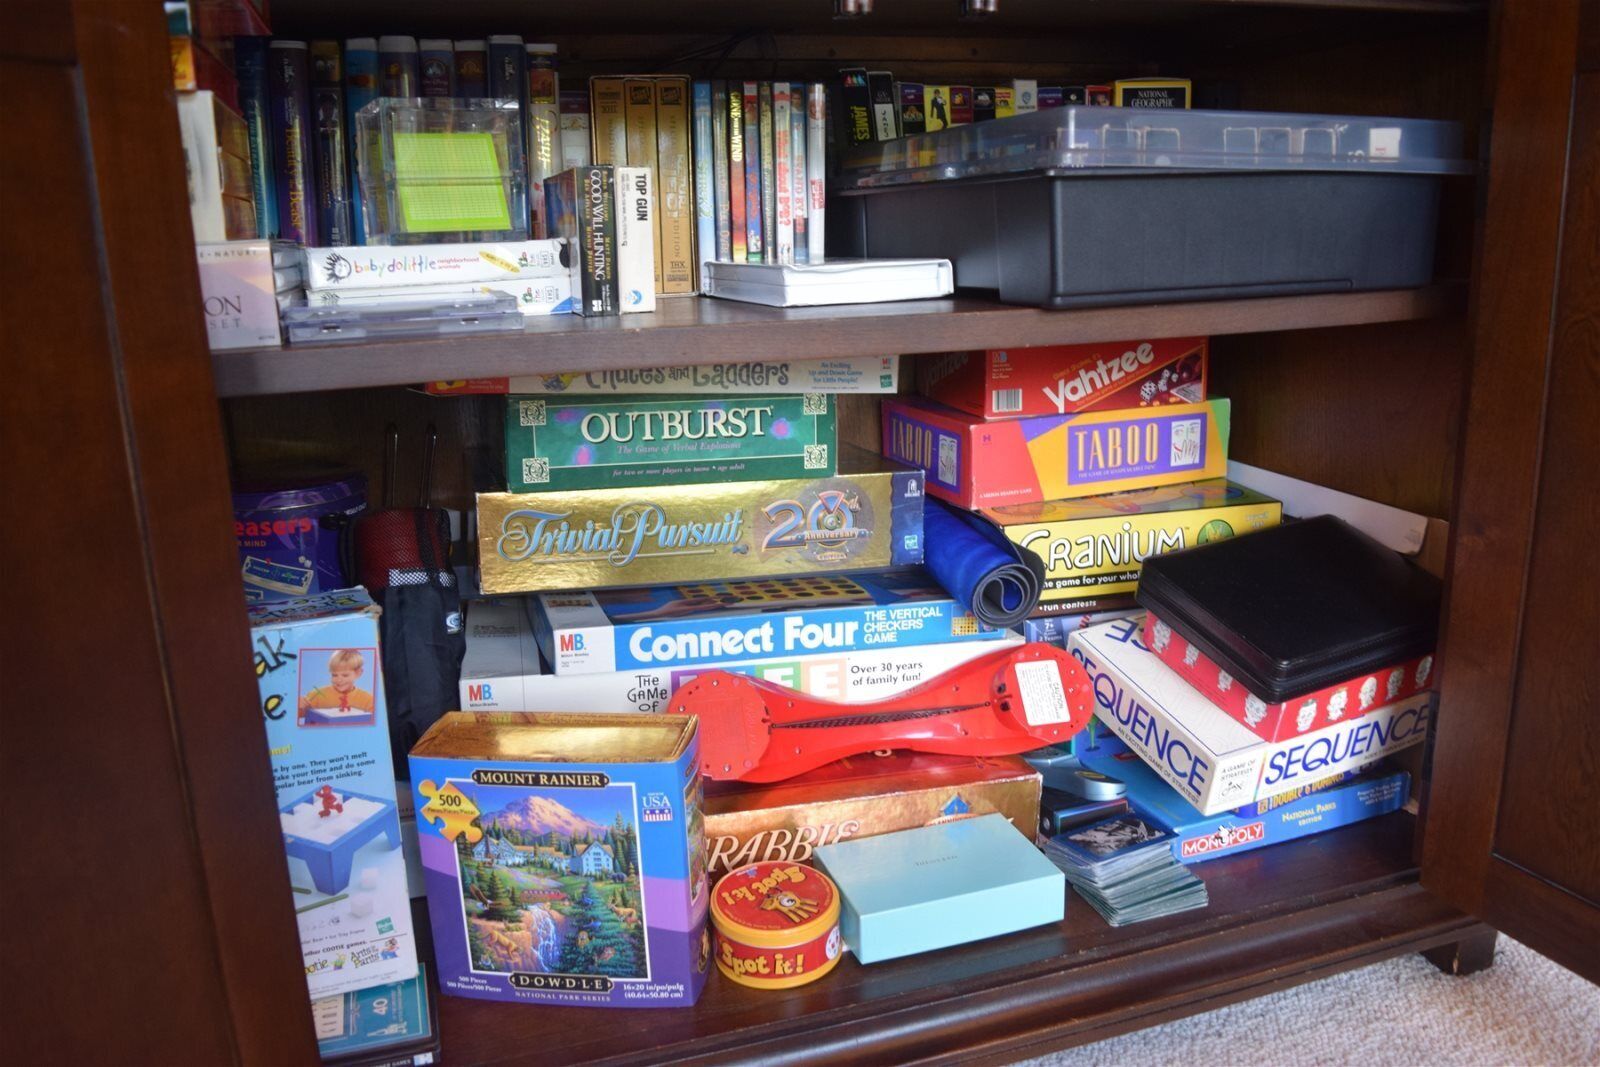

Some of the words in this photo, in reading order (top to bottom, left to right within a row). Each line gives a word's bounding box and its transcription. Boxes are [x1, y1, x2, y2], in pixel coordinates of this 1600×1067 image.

[730, 91, 741, 118] GONE
[851, 105, 870, 141] JAMES
[732, 135, 743, 162] WIND
[591, 170, 602, 203] GOOD
[635, 174, 647, 195] TOP
[289, 191, 305, 227] Beast
[592, 204, 604, 230] WILL
[636, 198, 648, 221] GUN
[437, 257, 480, 265] neighborhood
[594, 232, 606, 281] HUNTING
[354, 257, 386, 278] baby
[210, 318, 241, 330] SET
[668, 367, 689, 380] and
[1042, 342, 1155, 414] Yahtzee
[580, 406, 772, 443] OUTBURST
[617, 445, 633, 454] The
[636, 444, 659, 454] Game
[662, 444, 670, 454] of
[673, 443, 698, 451] Verbal
[892, 418, 932, 470] TABOO
[1075, 422, 1159, 471] TABOO
[612, 469, 622, 477] for
[662, 466, 682, 476] players
[233, 516, 312, 537] easers
[497, 508, 624, 562] Trivial
[608, 500, 744, 568] Pursuit
[804, 527, 859, 540] Anniversary
[1042, 578, 1053, 589] he
[1055, 579, 1081, 589] game
[1082, 575, 1095, 584] for
[1097, 576, 1118, 587] your
[1119, 571, 1141, 581] whol
[864, 610, 886, 621] THE
[889, 606, 943, 620] VERTICAL
[1062, 600, 1097, 610] contests
[864, 619, 923, 633] CHECKERS
[629, 620, 774, 663] Connect
[784, 615, 859, 651] Four
[864, 632, 897, 644] GAME
[253, 635, 297, 678] ak
[850, 664, 878, 674] Over
[880, 662, 892, 672] 30
[896, 661, 923, 673] years
[852, 677, 864, 686] of
[866, 674, 898, 688] family
[902, 672, 922, 682] fun!
[1264, 704, 1430, 785] SEQUENCE
[280, 764, 289, 773] by
[310, 759, 327, 768] They
[329, 754, 349, 763] won't
[351, 751, 367, 760] melt
[292, 771, 309, 780] your
[310, 767, 327, 775] time
[329, 763, 343, 772] and
[356, 759, 376, 767] some
[1118, 726, 1126, 737] AN
[1124, 731, 1149, 758] EXCITING
[1149, 753, 1164, 774] GAME
[1163, 769, 1172, 779] OF
[1171, 776, 1200, 805] STRATEGY
[1227, 762, 1246, 773] GAME
[1247, 759, 1256, 767] OF
[297, 778, 314, 786] bear
[316, 775, 333, 783] from
[335, 770, 365, 780] sinking.
[479, 771, 536, 786] MOUNT
[538, 773, 602, 787] RAINIER
[1221, 767, 1253, 780] STRATEGY
[439, 794, 461, 807] 500
[642, 796, 671, 808] USA
[1272, 788, 1303, 808] DOUBLE
[1299, 815, 1322, 826] EDITION
[705, 819, 860, 872] RABBLE
[1183, 826, 1264, 857] MONOPOLY
[751, 866, 807, 895] Spot
[721, 885, 757, 906] it!
[303, 949, 321, 957] other
[322, 944, 345, 954] COOTIE
[346, 940, 368, 949] games.
[721, 942, 771, 978] Spot
[774, 952, 805, 975] it!
[470, 976, 487, 984] Pieces
[646, 982, 685, 992] in/po/pulg
[515, 991, 558, 1000] NATIONAL
[582, 994, 611, 1002] SERIES
[670, 991, 684, 999] cm)
[373, 998, 388, 1016] 40
